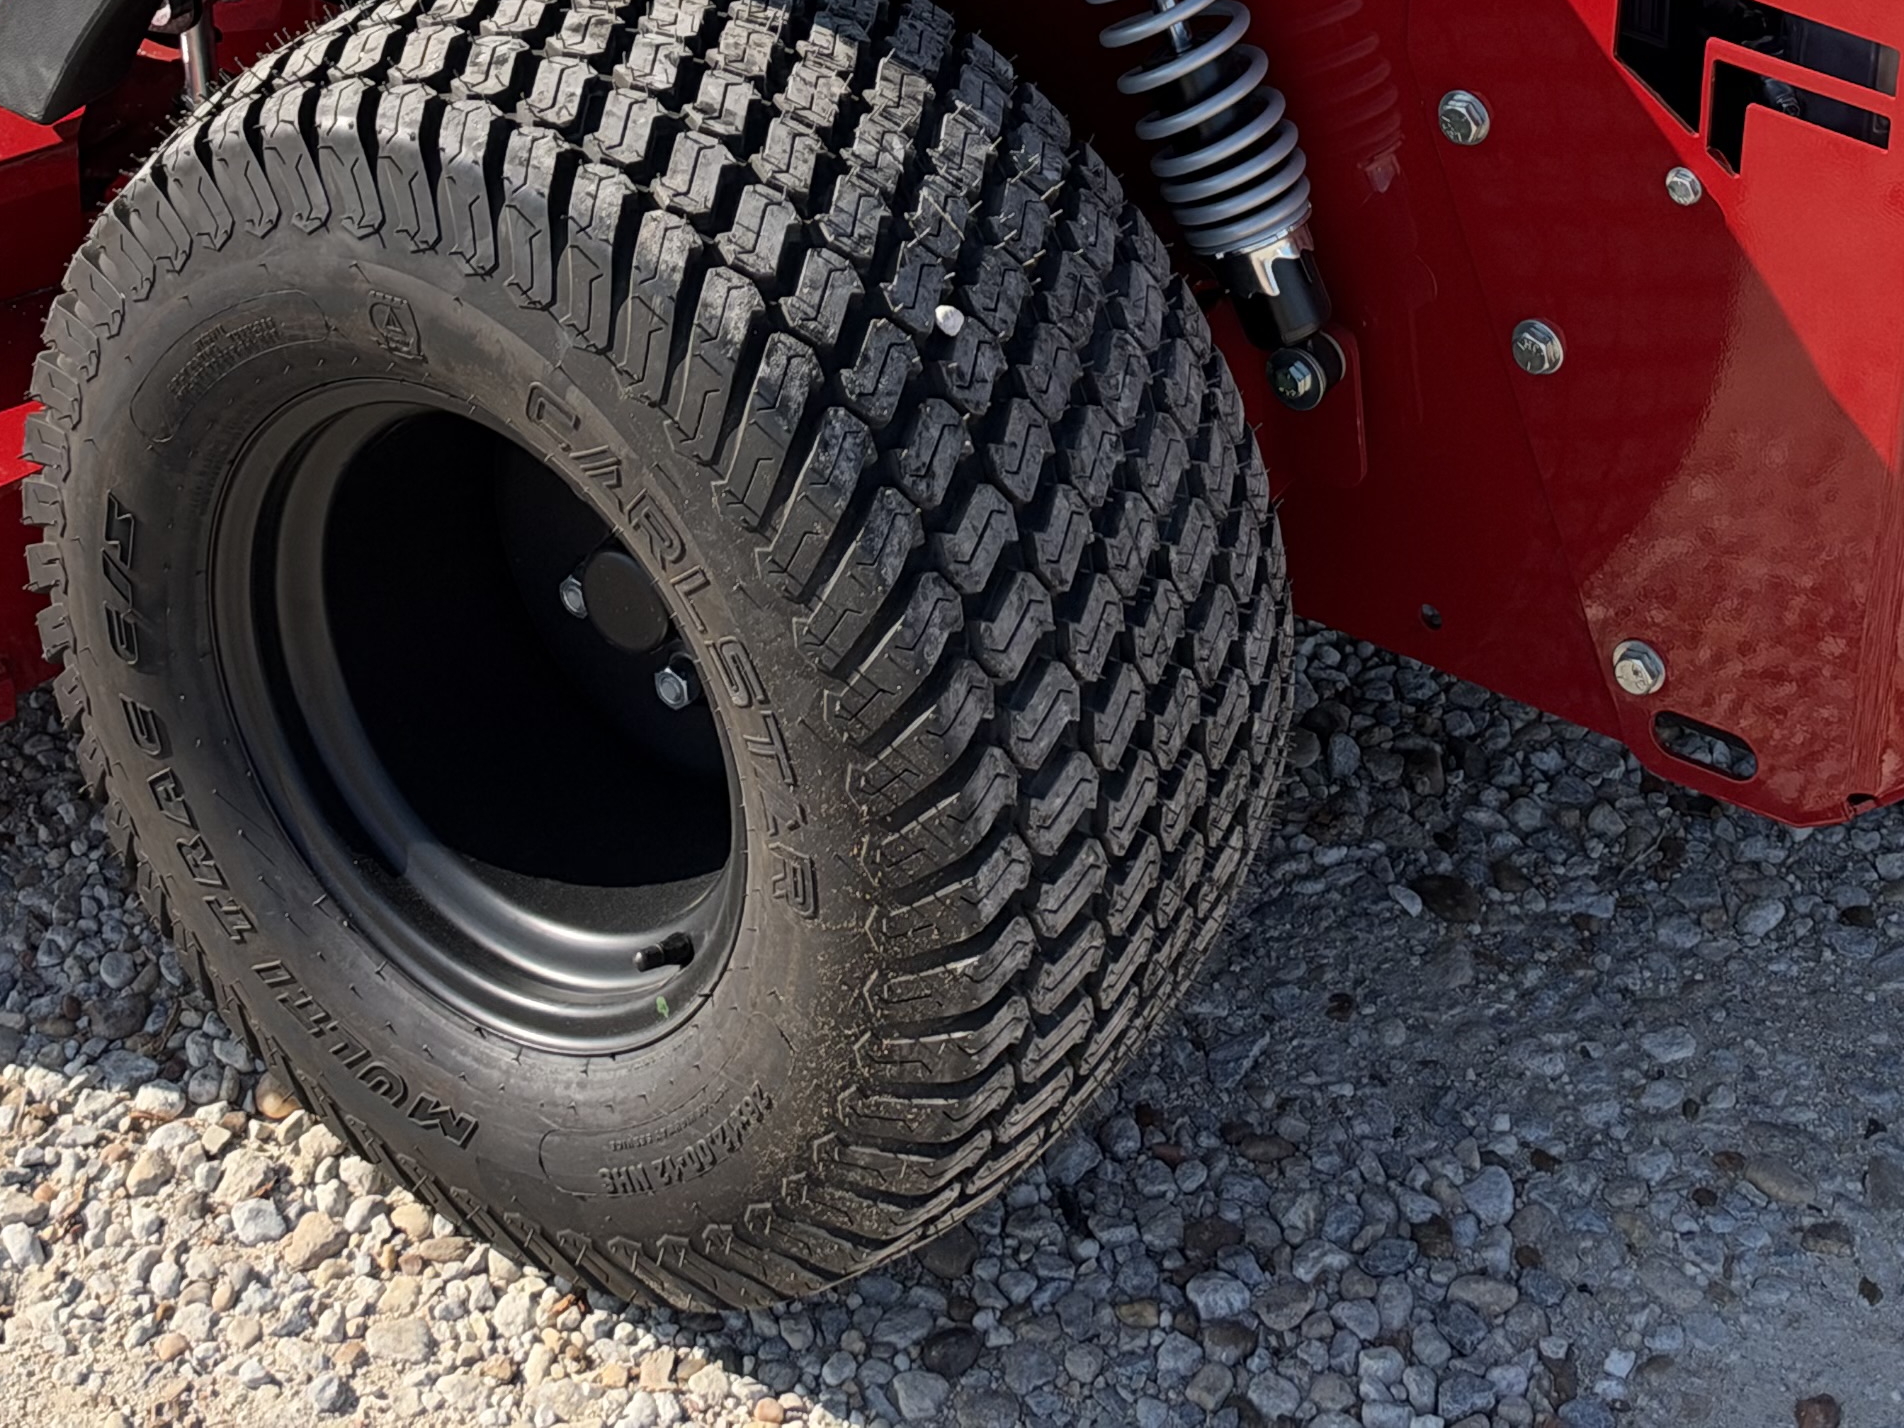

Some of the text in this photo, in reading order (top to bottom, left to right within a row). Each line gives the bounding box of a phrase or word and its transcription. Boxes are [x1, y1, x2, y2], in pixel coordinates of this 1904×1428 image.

[526, 381, 819, 920] CARLSTAR
[119, 693, 258, 940] TRAC
[252, 959, 480, 1150] MULTI
